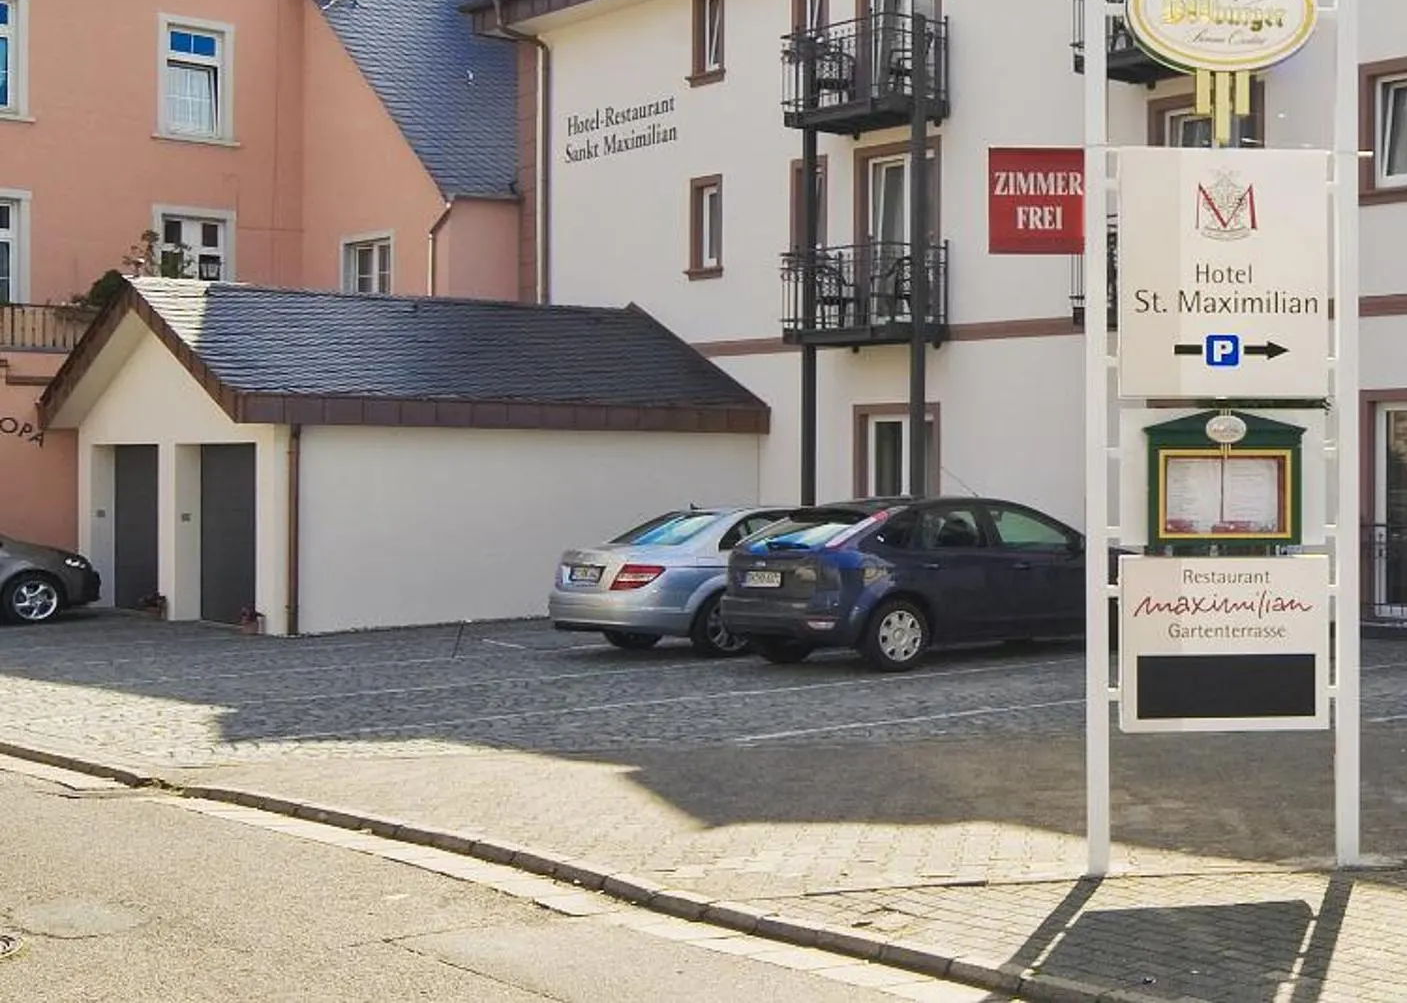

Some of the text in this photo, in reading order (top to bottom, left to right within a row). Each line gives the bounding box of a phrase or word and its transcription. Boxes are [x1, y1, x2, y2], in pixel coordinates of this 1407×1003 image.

[567, 95, 676, 137] Hotel-Restaurant
[564, 123, 678, 164] Sankt Maximilian
[994, 171, 1084, 196] ZIMMER
[1017, 206, 1063, 230] FREI
[1195, 263, 1253, 284] Hotel
[1134, 289, 1319, 314] St. Maximilian
[1182, 568, 1271, 584] Restaurant
[1167, 623, 1287, 639] Gartenterrasse
